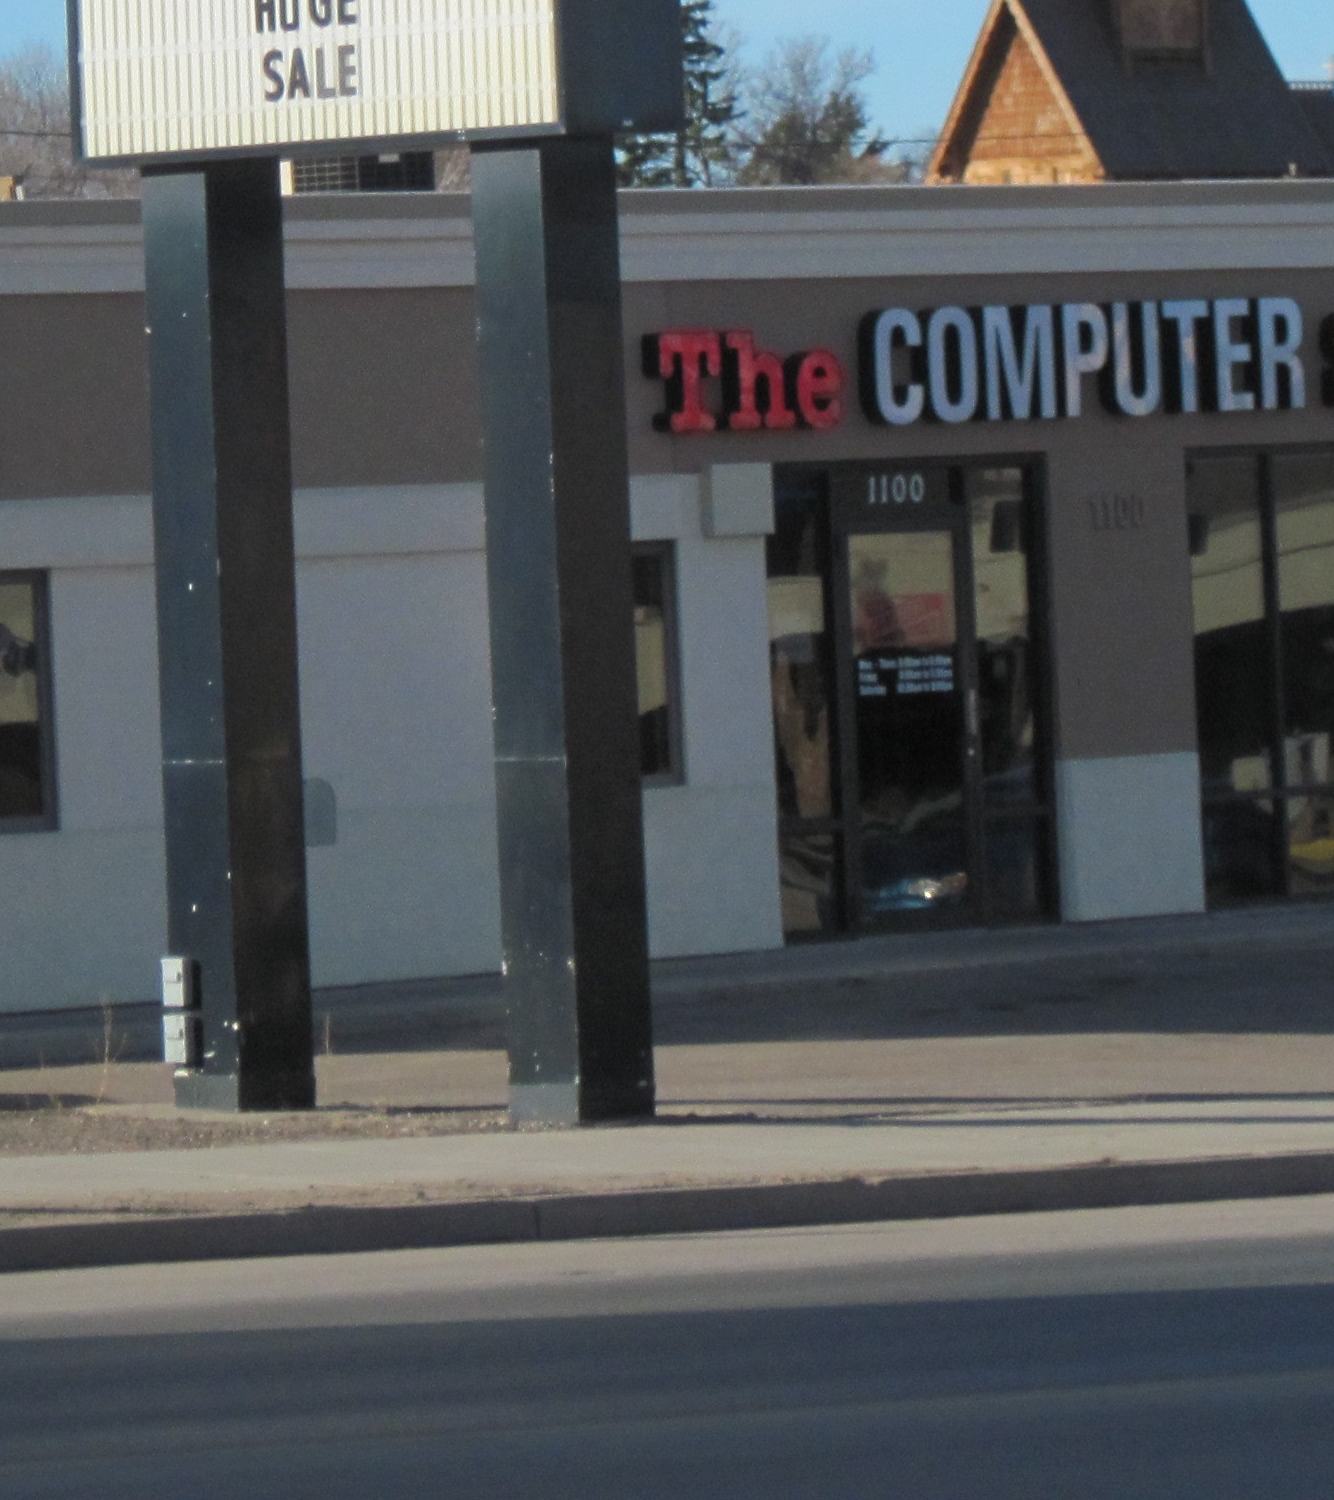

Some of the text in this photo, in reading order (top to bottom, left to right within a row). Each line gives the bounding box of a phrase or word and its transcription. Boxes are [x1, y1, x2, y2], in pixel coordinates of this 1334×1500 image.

[263, 44, 357, 102] SALE
[657, 330, 842, 432] The
[874, 297, 1306, 425] COMPUTER
[869, 474, 924, 503] 1100
